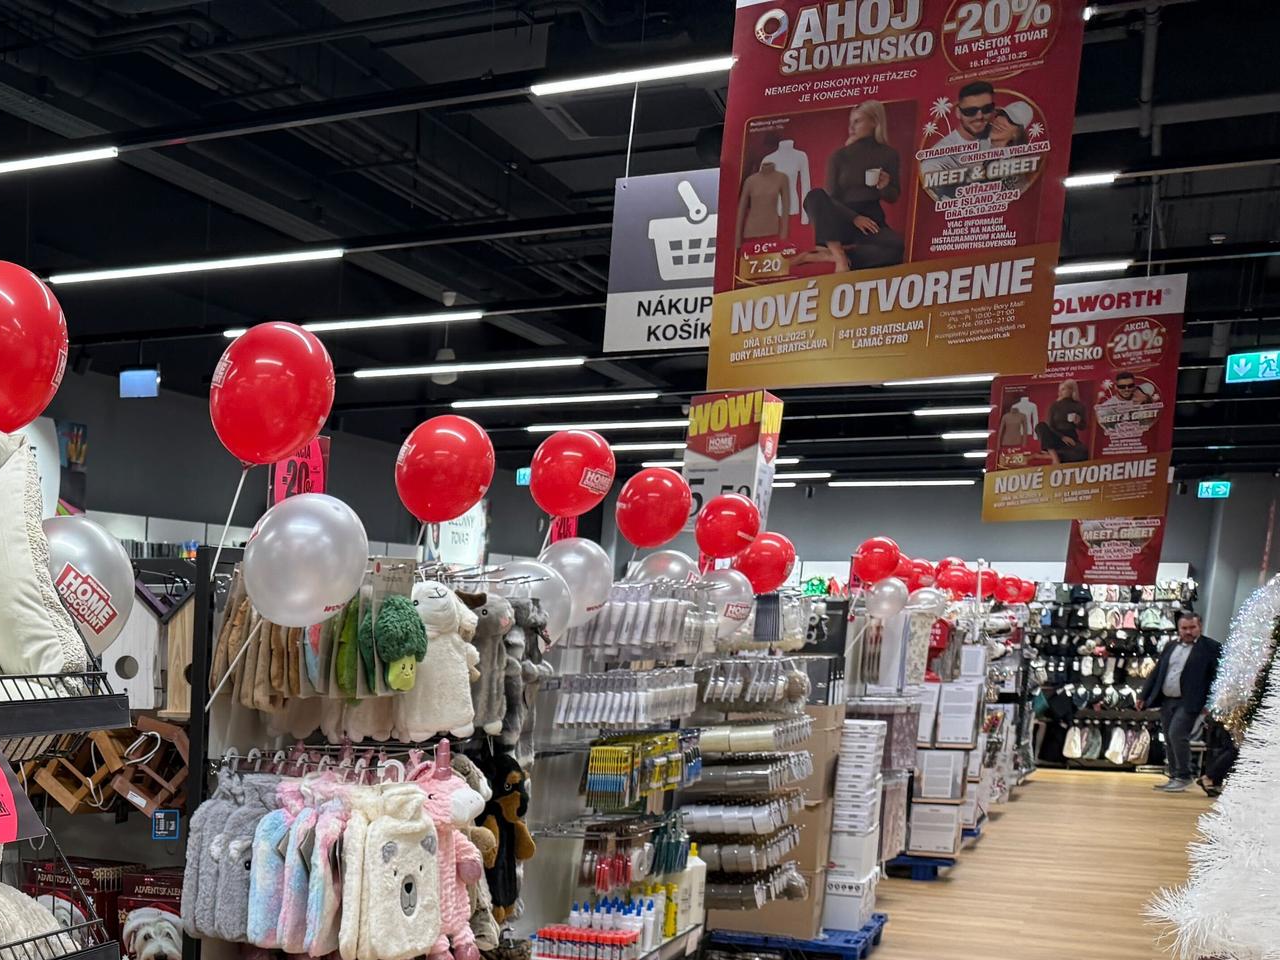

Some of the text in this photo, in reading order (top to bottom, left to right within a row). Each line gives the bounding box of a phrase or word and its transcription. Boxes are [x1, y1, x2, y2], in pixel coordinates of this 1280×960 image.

[790, 0, 920, 49] AHOJ
[944, 0, 1052, 41] -20%
[782, 31, 934, 74] SLOVENSKO
[954, 29, 1048, 56] NA VŠETOK TOVAR
[765, 69, 918, 96] NEMECKÝ DISKONTNÝ REŤAZEC
[798, 85, 879, 103] JE KONEČNE TU!
[924, 156, 1040, 187] MEET & GREET
[936, 190, 1019, 211] LOVE ISLAND 2024
[749, 258, 782, 274] 7.20
[637, 295, 713, 317] NÁKUP
[731, 257, 1035, 334] NOVÉ OTVORENIE
[1052, 289, 1162, 315] OLWORTH
[839, 320, 925, 340] 841 03 BRATISLAVA
[1048, 325, 1096, 350] HOJ
[1124, 321, 1150, 332] AKCIA
[730, 338, 828, 363] BORY MALL BRATISLAVA
[851, 334, 908, 349] LAMAČ 6780
[1048, 346, 1102, 362] VENSKO
[689, 390, 763, 437] WOW!
[995, 458, 1157, 494] NOVÉ OTVORENIE
[1083, 530, 1113, 540] MEET
[59, 583, 102, 630] DISCOUNT
[63, 570, 114, 624] HOME
